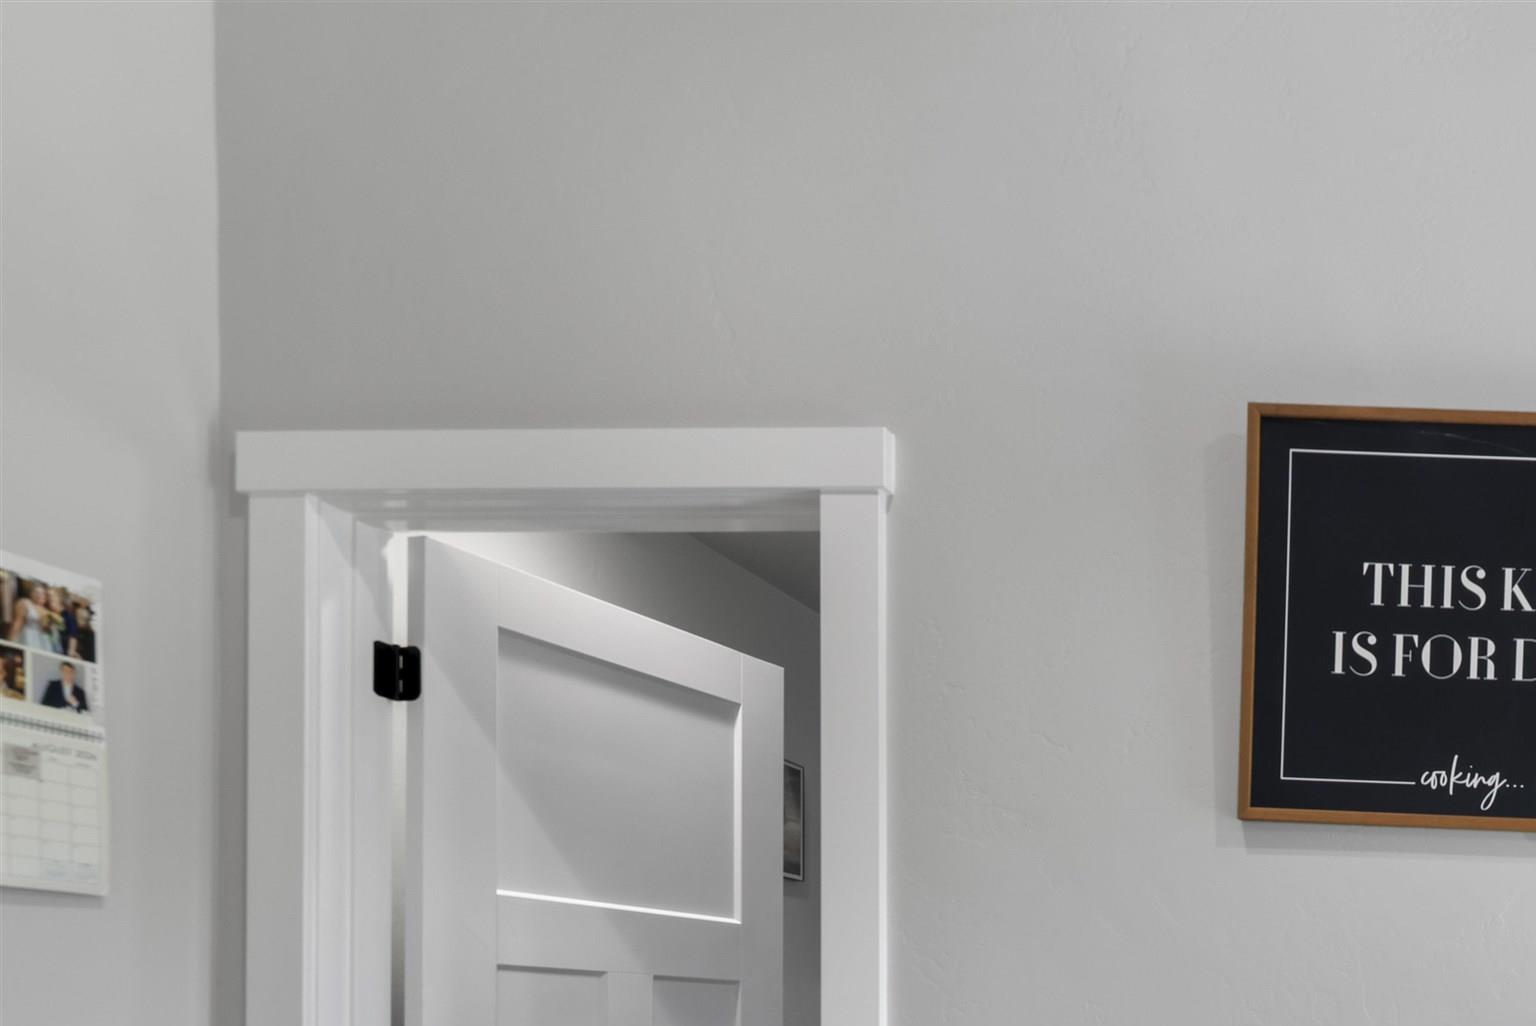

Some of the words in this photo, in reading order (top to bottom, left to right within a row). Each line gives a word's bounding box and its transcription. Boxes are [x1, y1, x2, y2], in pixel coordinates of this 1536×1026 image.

[1362, 561, 1488, 612] THIS
[1330, 630, 1379, 677] IS
[1390, 633, 1498, 681] FOR
[1420, 754, 1525, 811] cooking...
